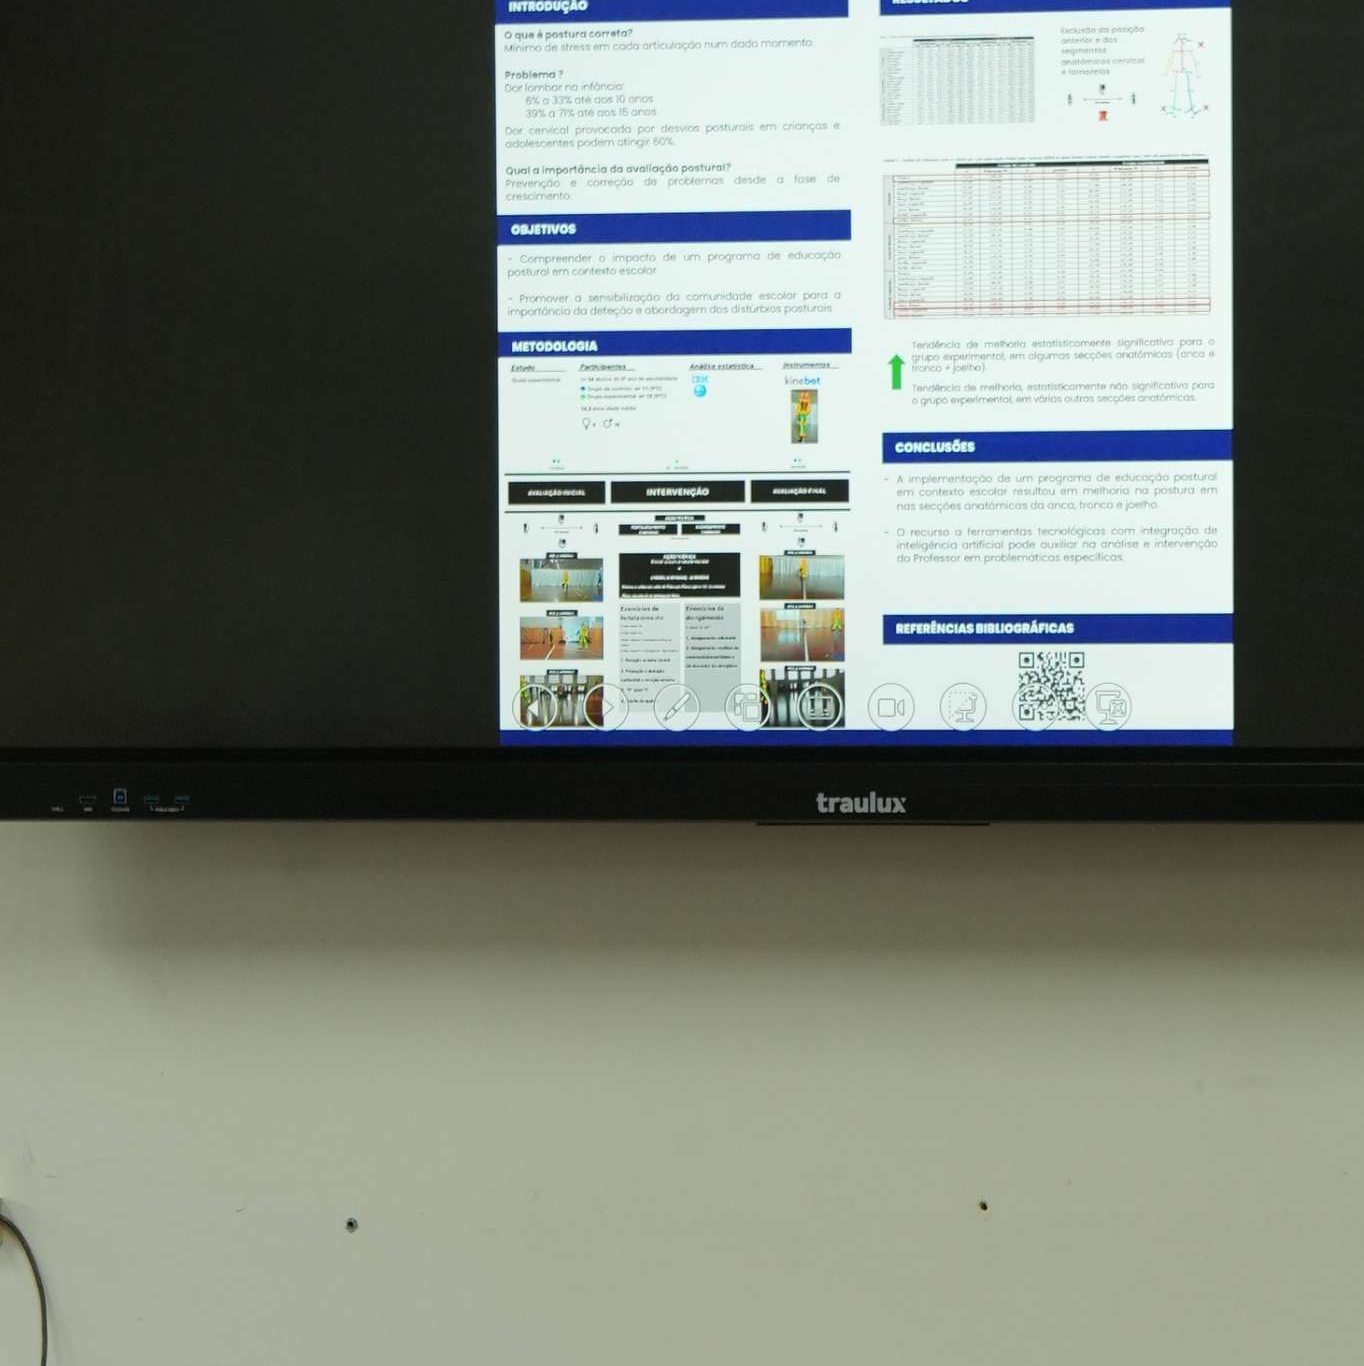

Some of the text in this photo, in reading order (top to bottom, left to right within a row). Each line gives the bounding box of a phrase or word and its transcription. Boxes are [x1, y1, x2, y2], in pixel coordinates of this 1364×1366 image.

[504, 30, 512, 39] O
[536, 30, 543, 38] é
[545, 30, 586, 39] postura
[589, 28, 632, 37] correta?
[504, 70, 557, 79] Problema
[505, 166, 530, 175] Qual
[541, 164, 607, 174] importância
[609, 164, 623, 173] da
[626, 163, 678, 173] avaliação
[680, 163, 731, 172] postural?
[510, 223, 577, 235] OBJETIVOS
[511, 340, 598, 351] METODOLOGIA
[784, 377, 821, 385] kinebot
[894, 439, 976, 452] CONCLUSÕES
[645, 487, 710, 496] INTERVENÇÃO
[895, 621, 1074, 634] REFERÊNCIAS BIBLIOGRÁFICAS
[815, 791, 906, 814] traulux
